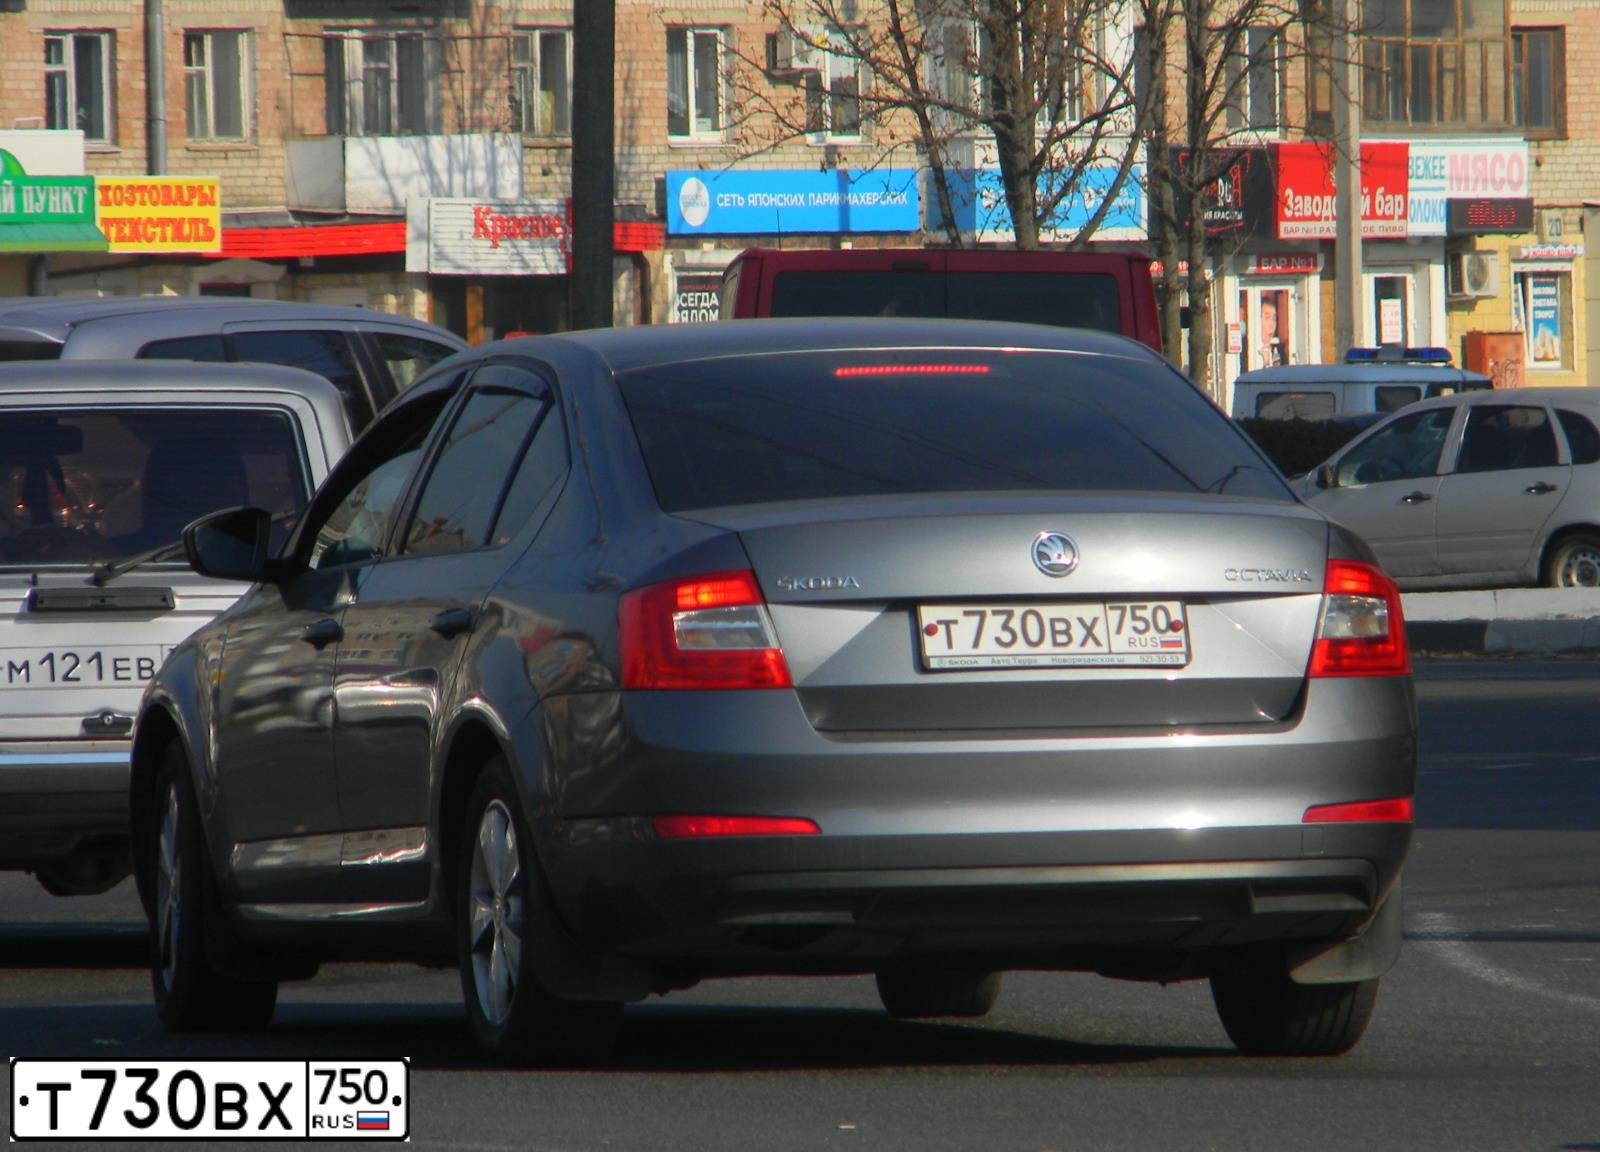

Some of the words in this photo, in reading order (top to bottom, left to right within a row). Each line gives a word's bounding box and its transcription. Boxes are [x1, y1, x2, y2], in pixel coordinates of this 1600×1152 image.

[1408, 156, 1445, 179] ВЕЖЕЕ
[1449, 153, 1525, 192] МЯСО
[22, 186, 88, 213] ПУНКТ
[98, 184, 216, 206] ХОЗТОВАРЫ
[716, 194, 744, 208] СЕТЬ
[748, 193, 805, 207] ЯПОНСКИХ
[808, 192, 908, 206] ПАРИКМАХЕРСКИХ
[1284, 187, 1370, 222] Заводй
[1375, 187, 1404, 222] бар
[1409, 198, 1446, 223] ОЛОКО
[100, 217, 216, 243] ТЕКСТИЛЬ
[1261, 257, 1287, 269] БАР
[1224, 568, 1312, 582] OCTAVIA
[1108, 604, 1172, 635] 750
[1128, 636, 1159, 648] RUS
